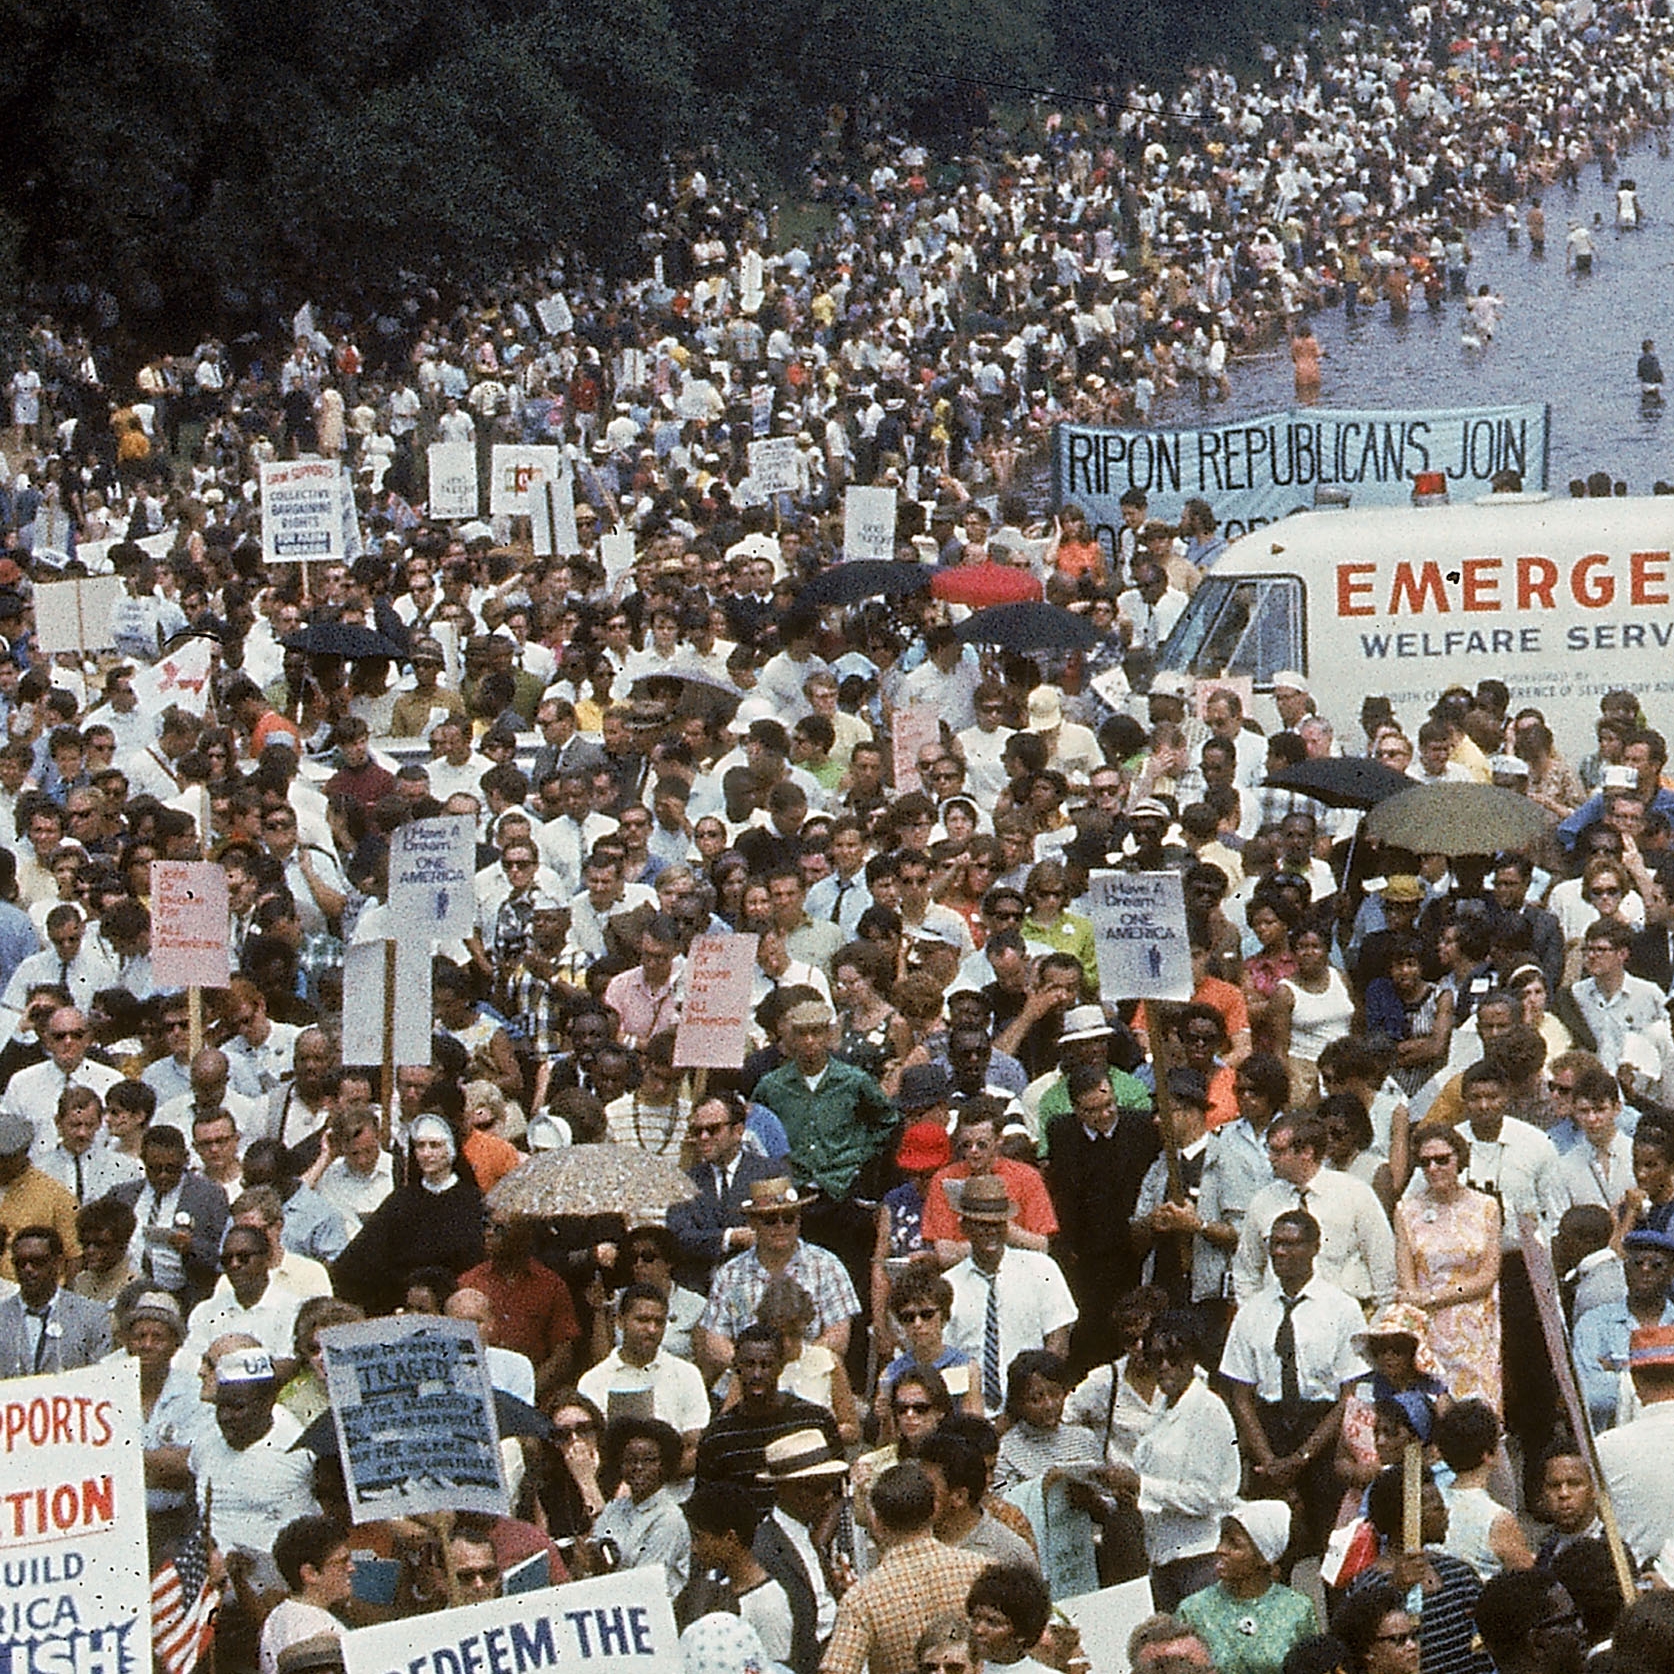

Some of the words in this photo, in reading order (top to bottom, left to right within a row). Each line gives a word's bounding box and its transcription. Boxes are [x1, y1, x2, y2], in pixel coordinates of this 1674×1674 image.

[1068, 431, 1181, 494] RIPON
[1199, 421, 1430, 493] REPUBLICANS
[1446, 417, 1527, 481] JOIN
[1360, 627, 1542, 659] WELFARE
[416, 856, 447, 870] ONE
[400, 869, 466, 883] AMERICA
[1112, 883, 1149, 895] Have
[1119, 913, 1153, 926] ONE
[1105, 926, 1176, 940] AMERICA
[0, 1396, 113, 1453] PORTS
[566, 1606, 656, 1659] THE
